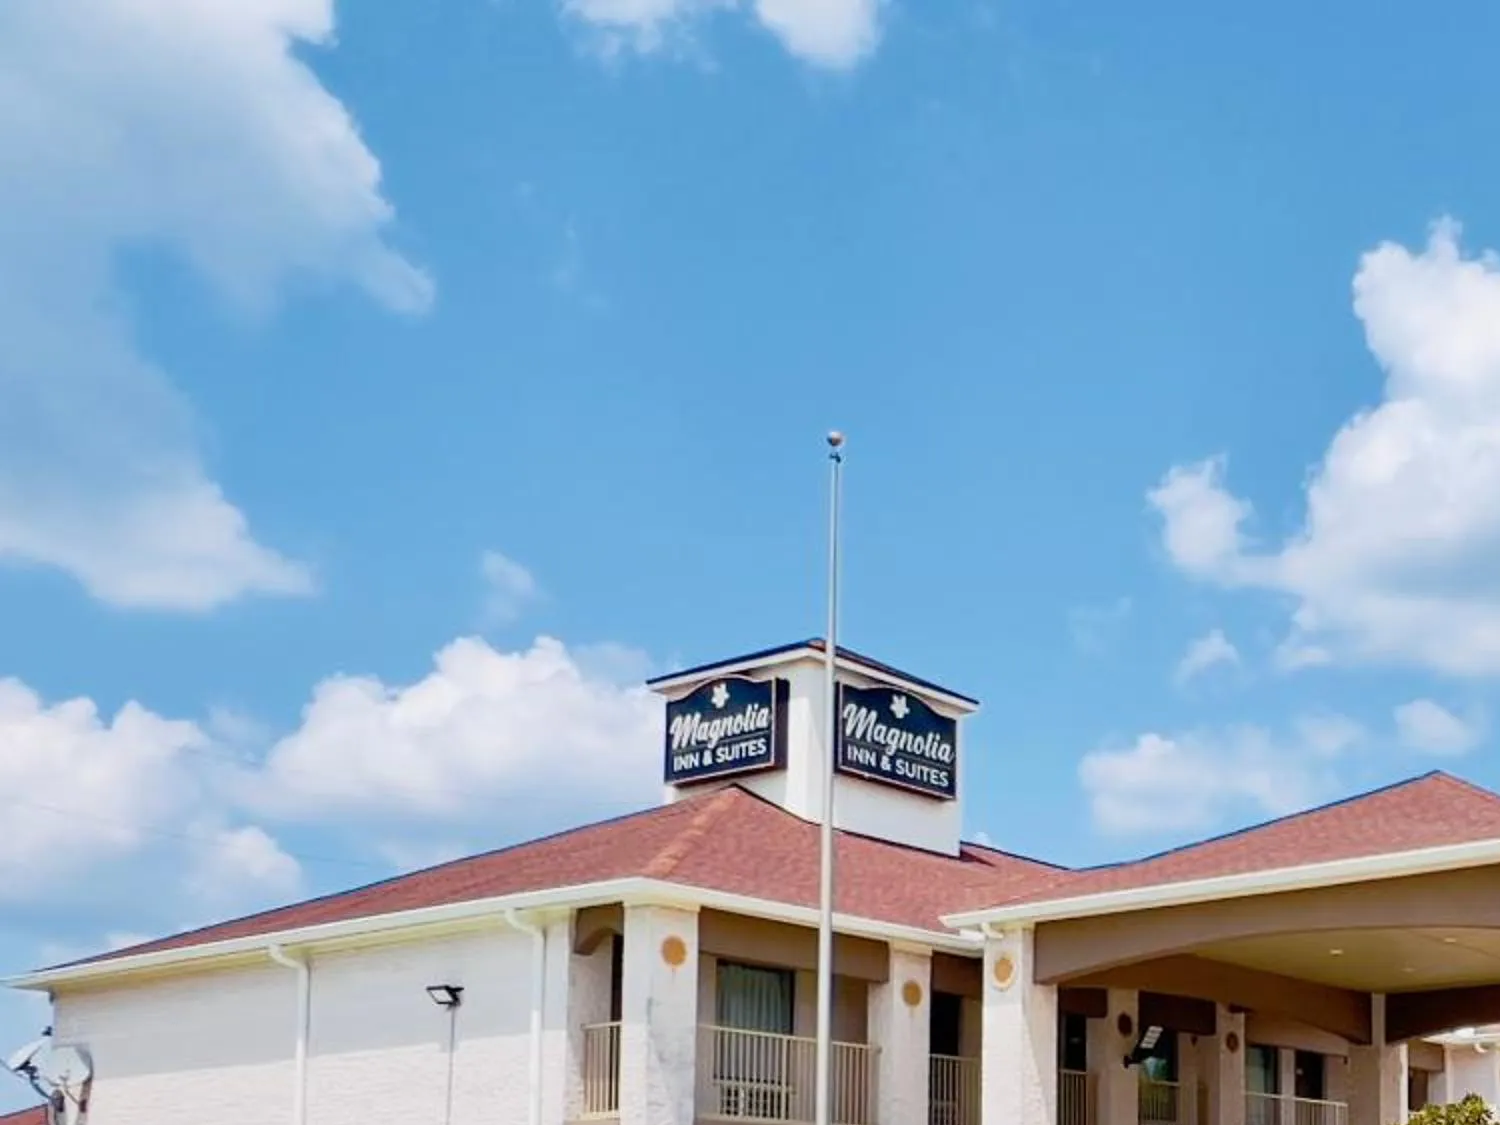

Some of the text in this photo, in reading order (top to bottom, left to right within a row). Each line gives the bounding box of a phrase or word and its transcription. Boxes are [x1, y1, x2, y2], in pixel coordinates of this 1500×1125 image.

[669, 703, 770, 750] Magnolia
[843, 703, 954, 763] Magnolia
[673, 738, 767, 772] INN & SUITES
[847, 743, 949, 787] INN & SUITES
